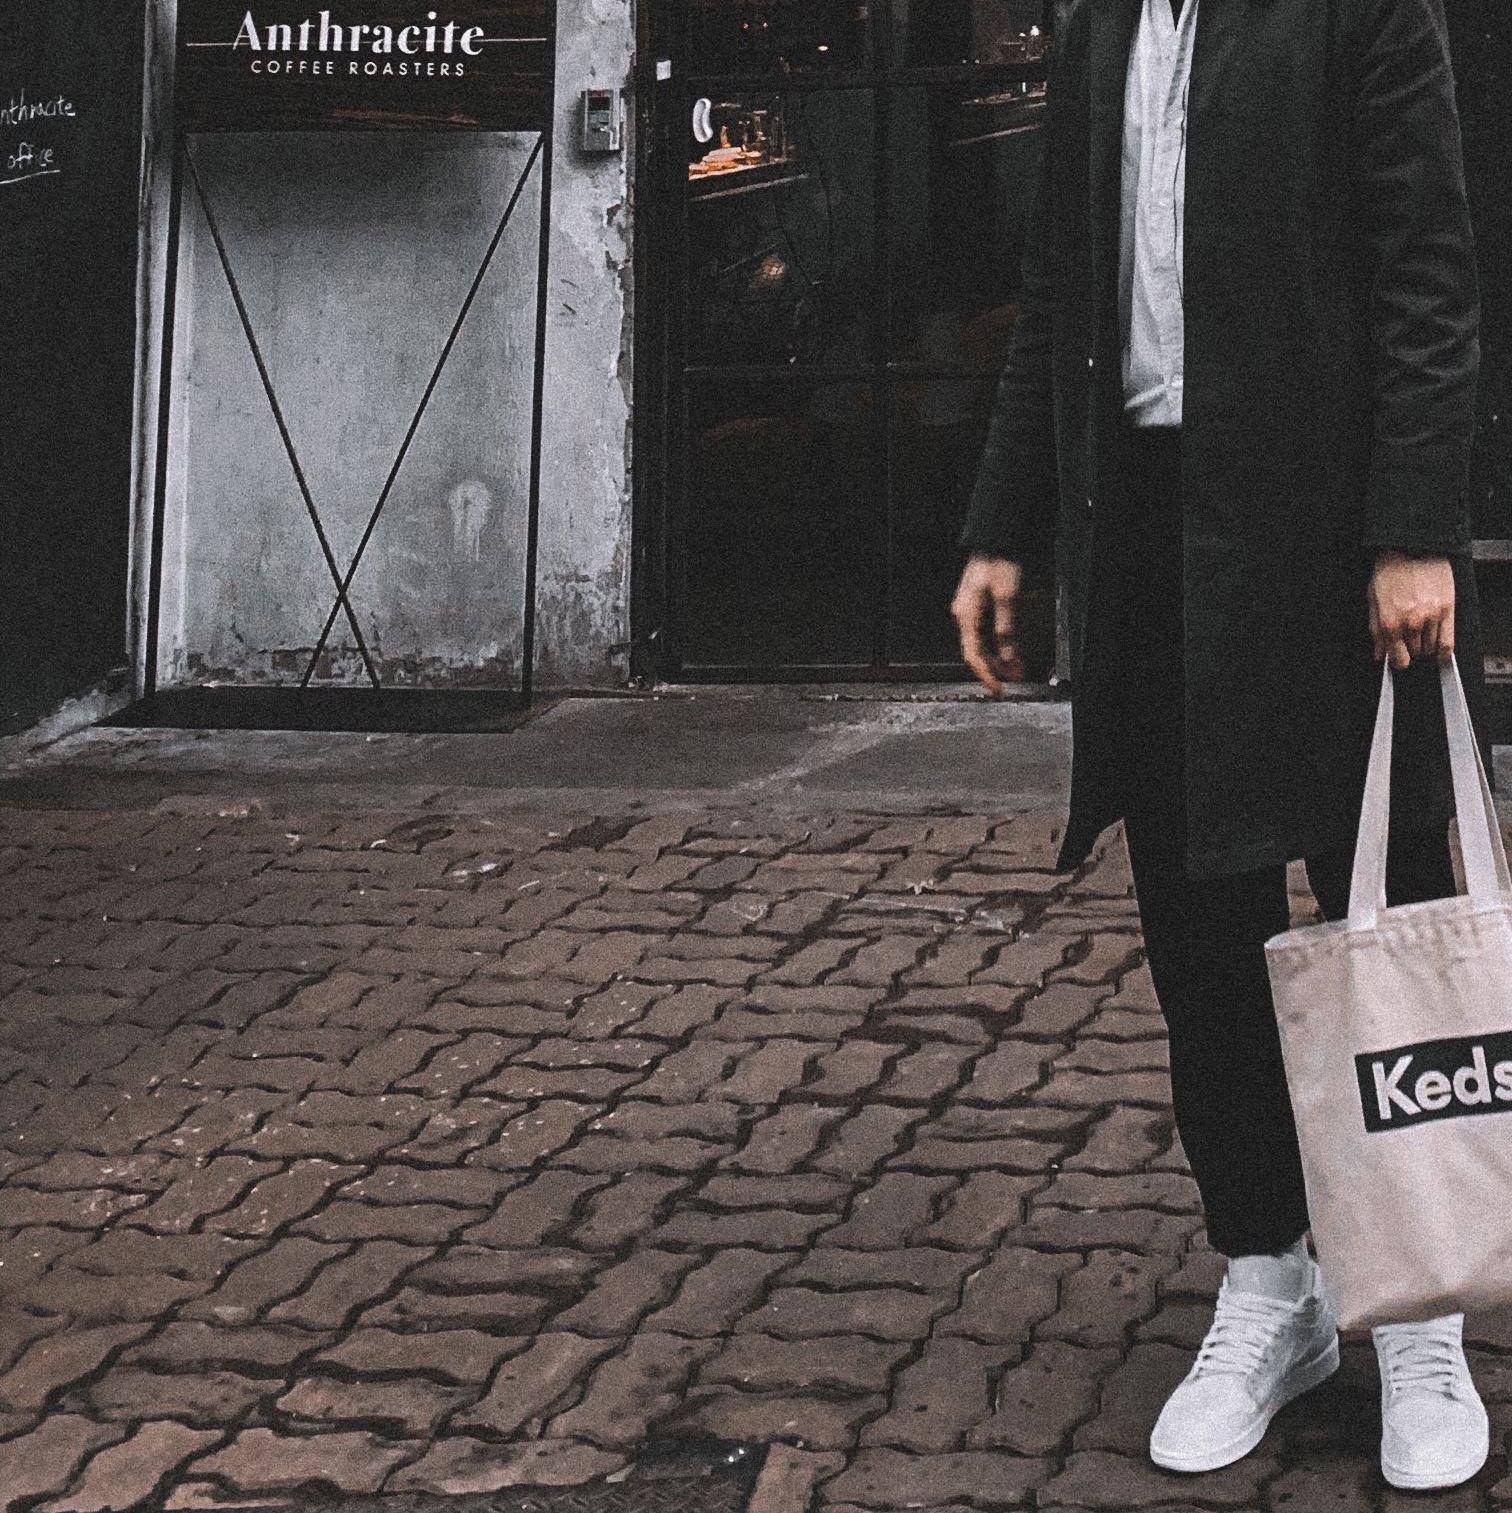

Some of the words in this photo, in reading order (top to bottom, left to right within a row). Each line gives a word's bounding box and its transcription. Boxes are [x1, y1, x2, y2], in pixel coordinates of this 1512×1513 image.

[232, 9, 485, 56] Anthracite
[250, 59, 335, 75] COFFEE
[349, 61, 465, 77] ROASTERS
[0, 88, 76, 125] nthracite
[8, 141, 54, 169] offce
